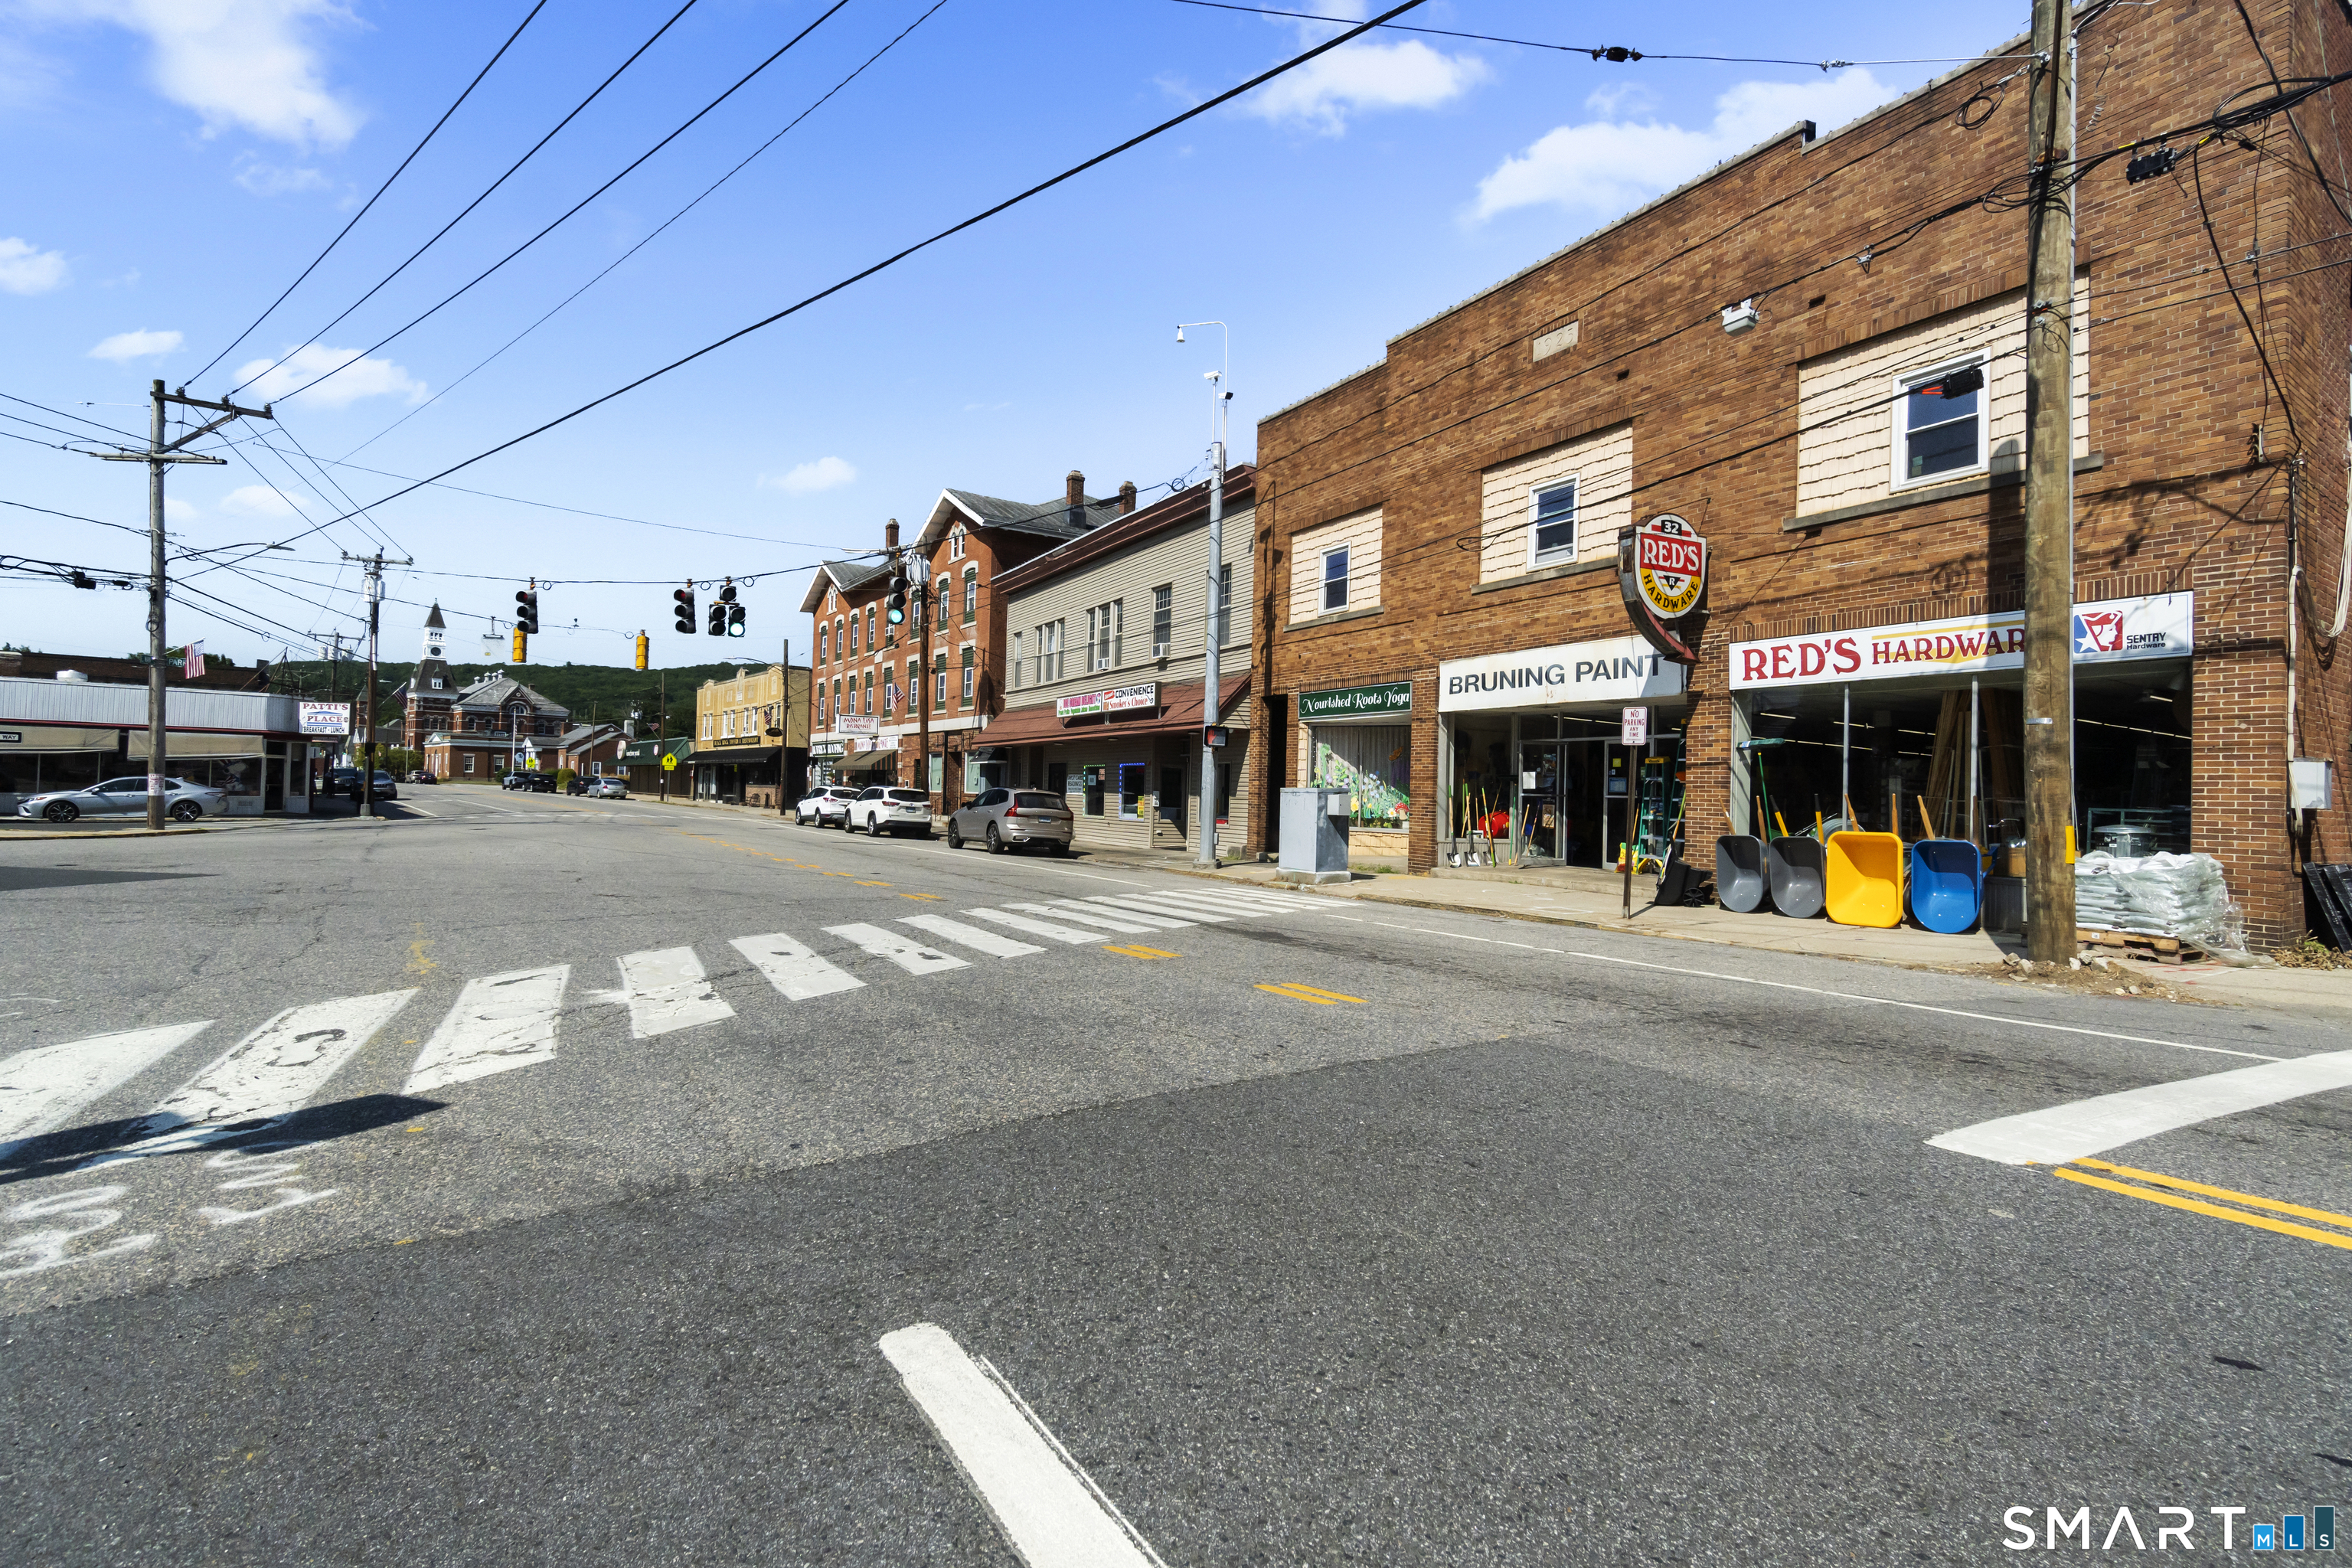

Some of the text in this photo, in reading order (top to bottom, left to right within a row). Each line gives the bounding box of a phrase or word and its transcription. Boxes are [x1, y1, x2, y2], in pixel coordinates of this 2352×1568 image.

[1664, 521, 1679, 534] 32
[1643, 538, 1699, 571] RED'S
[1644, 573, 1698, 609] HARDWARE
[1669, 577, 1675, 586] R
[2127, 632, 2166, 644] SENTRY
[1742, 628, 2025, 681] RED'S HARDWAR
[1449, 653, 1666, 694] BRUNING PAINT
[1116, 685, 1154, 698] CONVENIENCE
[1300, 687, 1410, 714] Nourished Roots Yoga
[1109, 696, 1148, 710] Smoker's Choice
